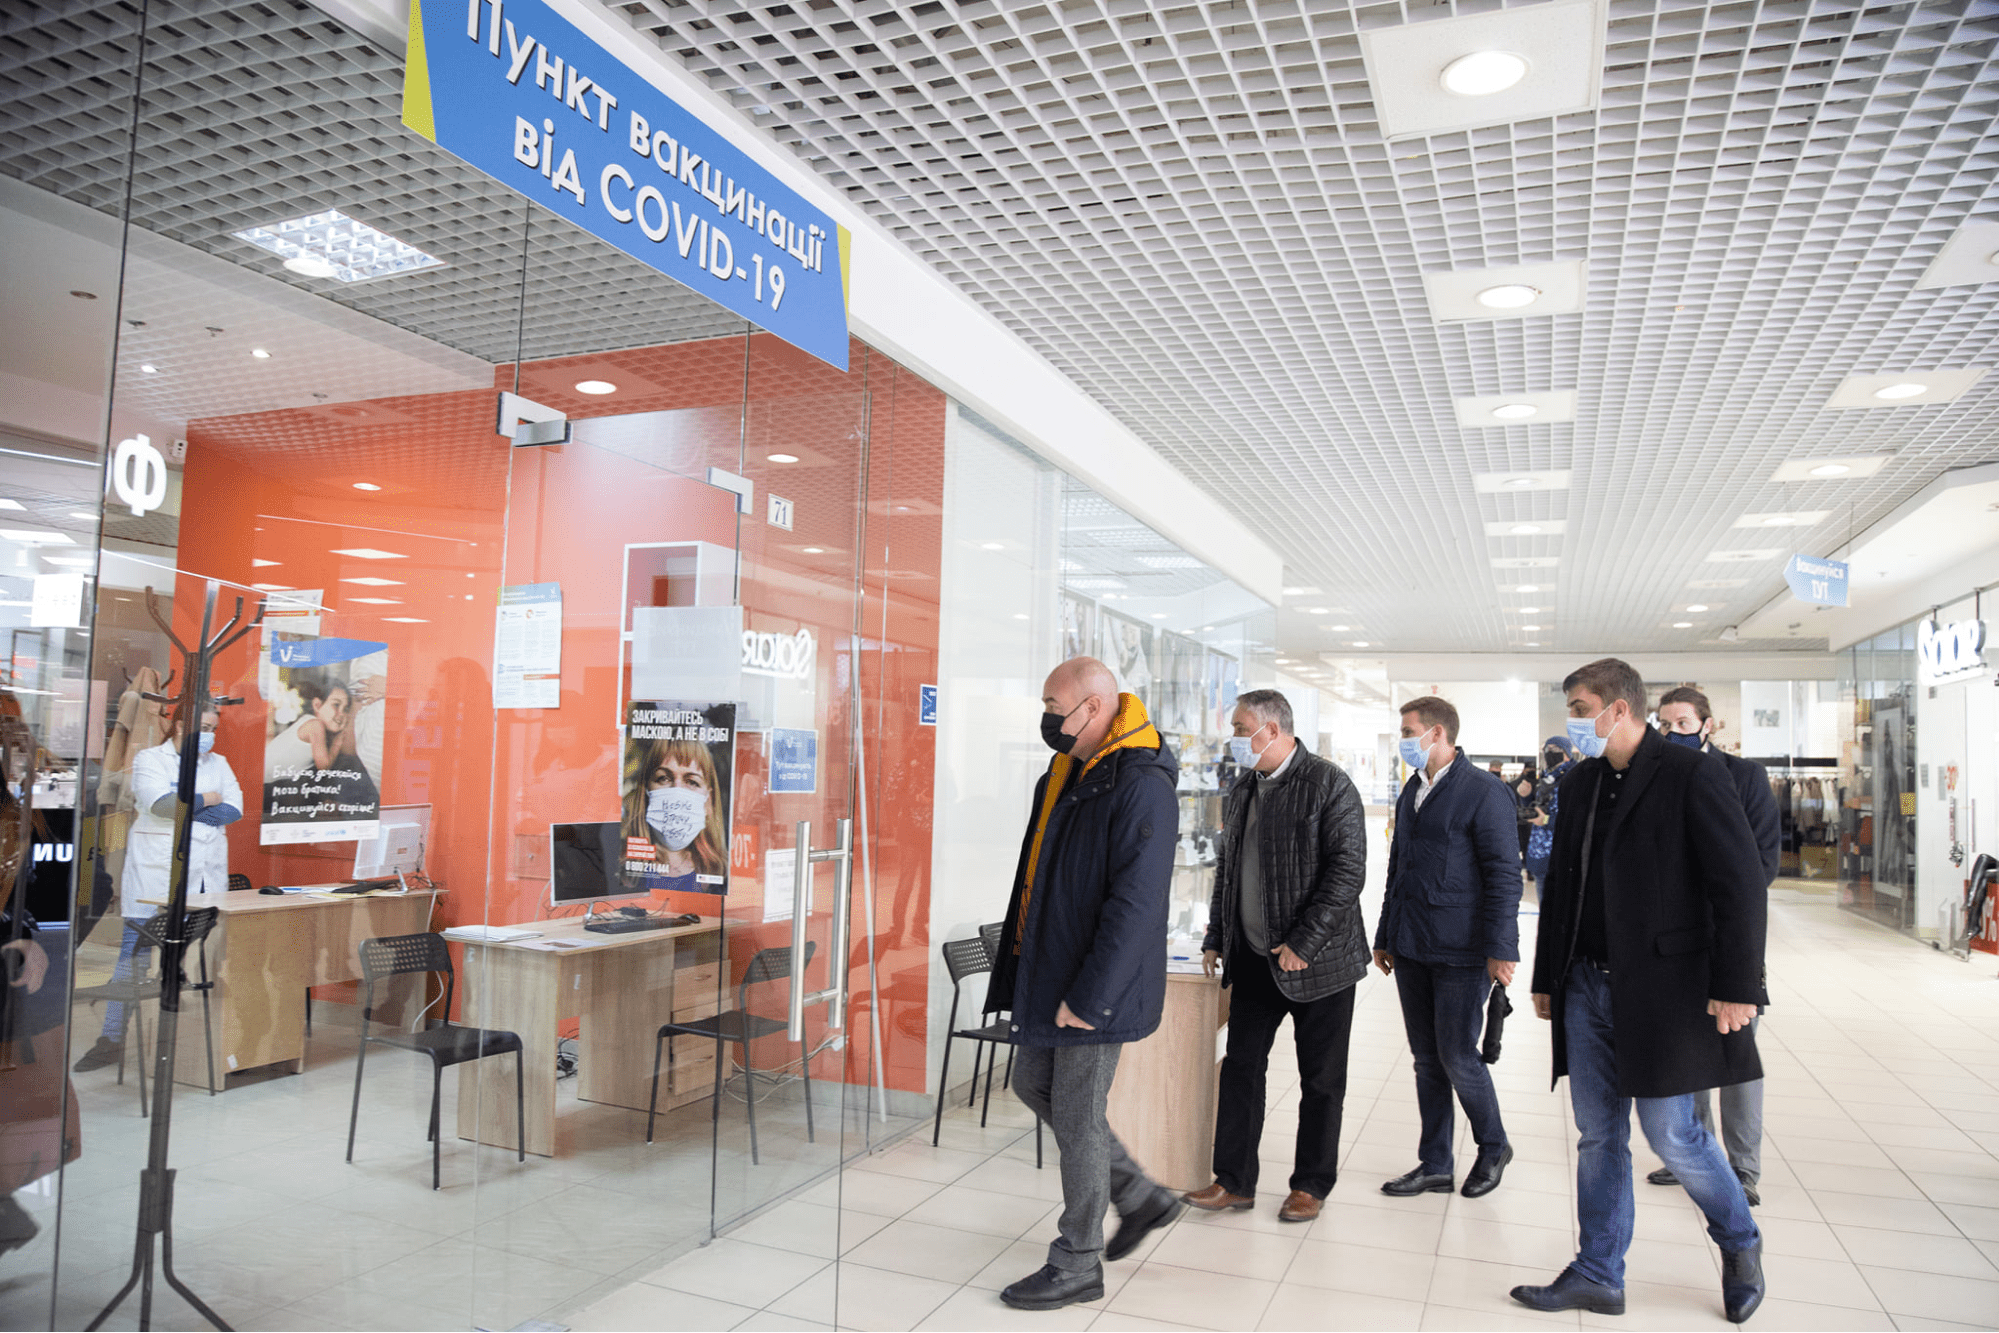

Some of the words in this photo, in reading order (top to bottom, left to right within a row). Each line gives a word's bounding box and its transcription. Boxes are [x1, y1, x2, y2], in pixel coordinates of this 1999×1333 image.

[467, 0, 618, 131] Пункт
[629, 110, 826, 273] вакцинації
[514, 115, 585, 205] від
[600, 164, 787, 311] COVID-19
[774, 500, 788, 526] 71
[632, 709, 704, 725] ЗАКРИВАЙТЕСЬ
[631, 725, 675, 742] МАСКОЮ,
[676, 726, 684, 741] А
[685, 726, 698, 741] НЕ
[699, 726, 707, 741] В
[707, 727, 729, 742] СОБІ
[271, 801, 336, 818] Вакцинуйся
